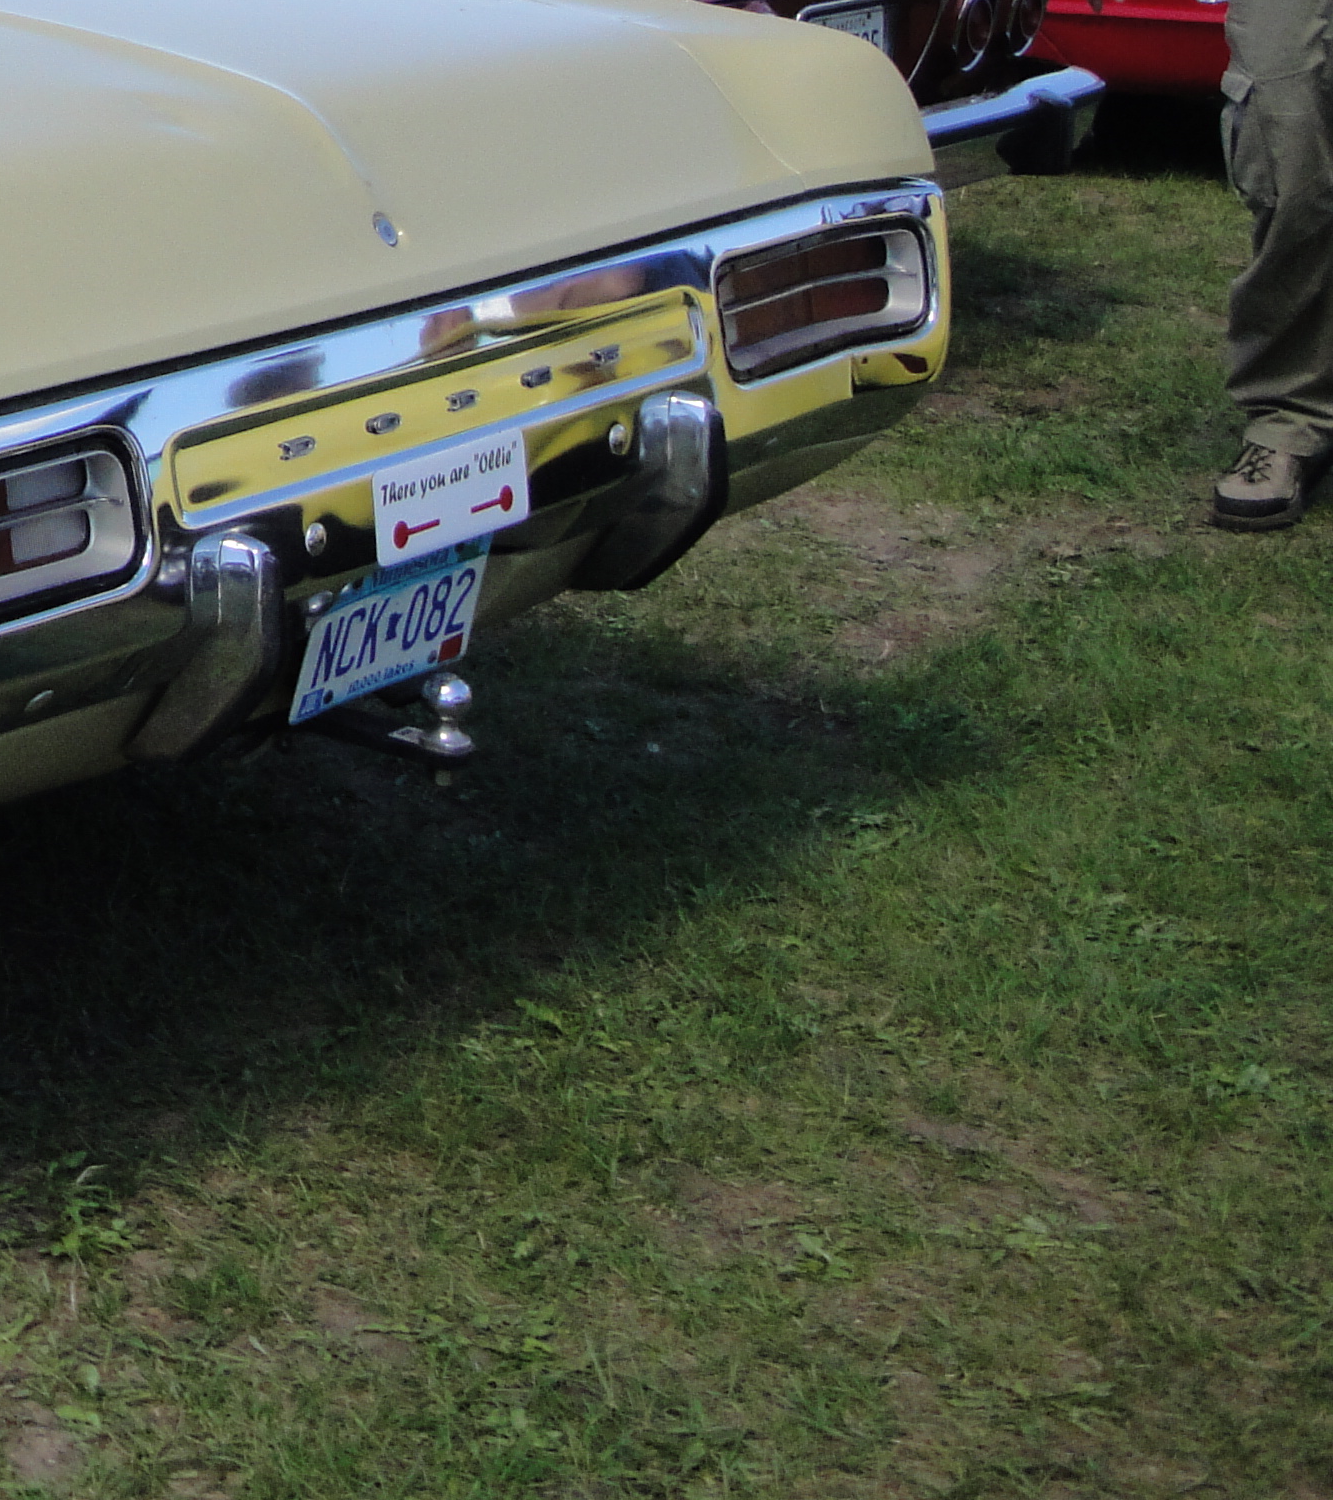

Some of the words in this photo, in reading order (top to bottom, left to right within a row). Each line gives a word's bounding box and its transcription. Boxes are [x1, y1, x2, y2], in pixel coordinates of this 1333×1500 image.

[380, 480, 416, 507] There
[420, 472, 446, 500] you
[450, 463, 470, 485] are
[473, 440, 517, 474] "Ollie"
[310, 596, 391, 689] NCK
[401, 567, 476, 651] 082
